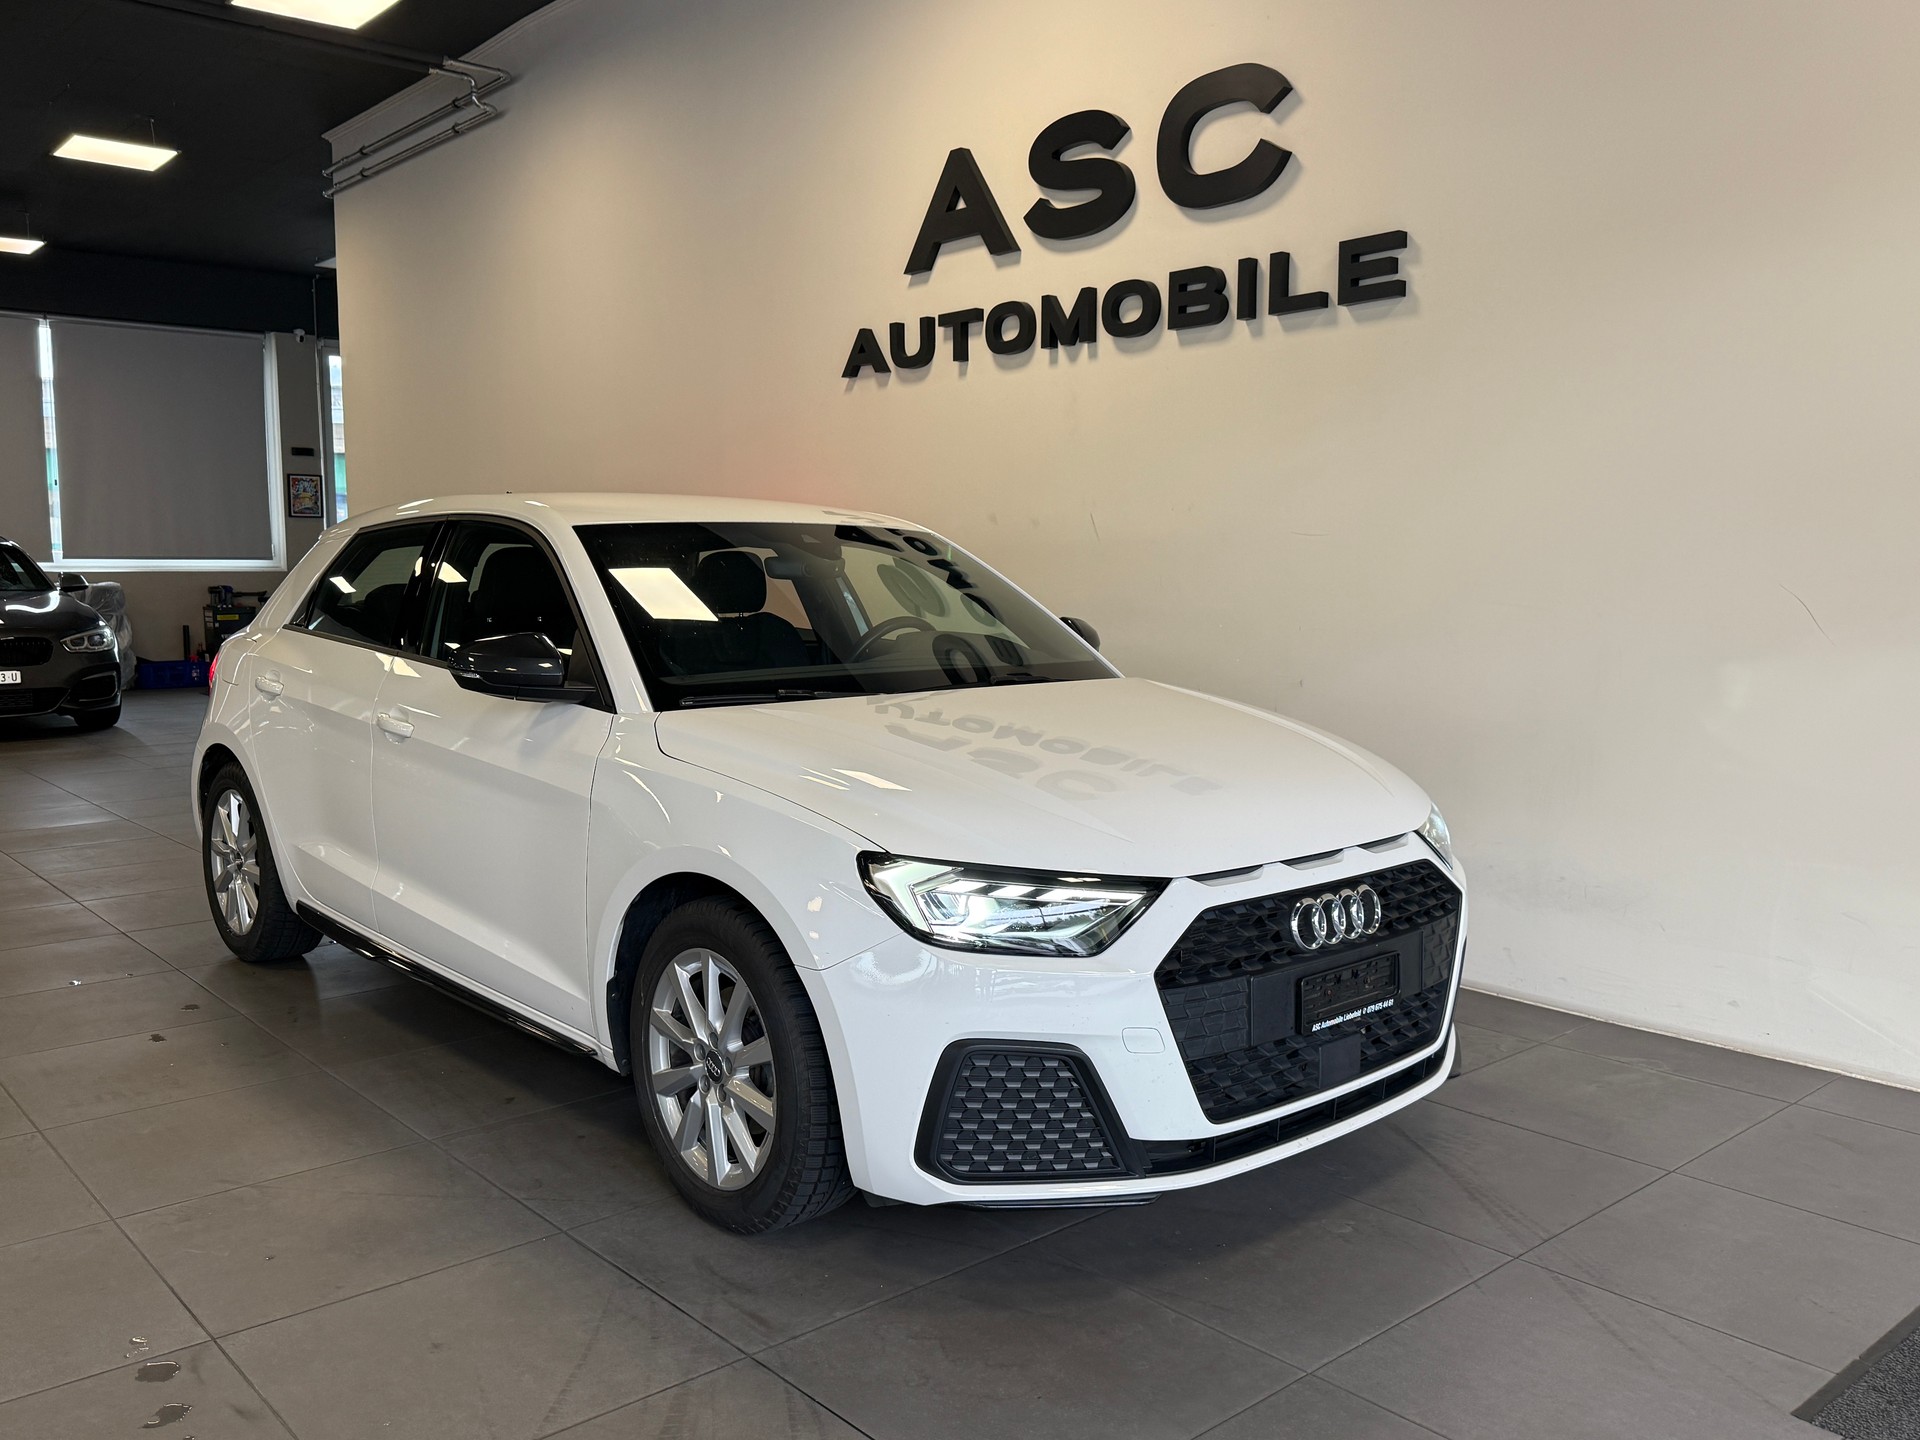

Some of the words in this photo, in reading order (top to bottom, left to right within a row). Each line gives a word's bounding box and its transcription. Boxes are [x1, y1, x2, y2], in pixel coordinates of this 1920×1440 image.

[903, 62, 1294, 276] ASC
[841, 229, 1408, 379] AUTOMOBILE
[1311, 1022, 1322, 1032] ASC
[1320, 1015, 1344, 1029] Automobile
